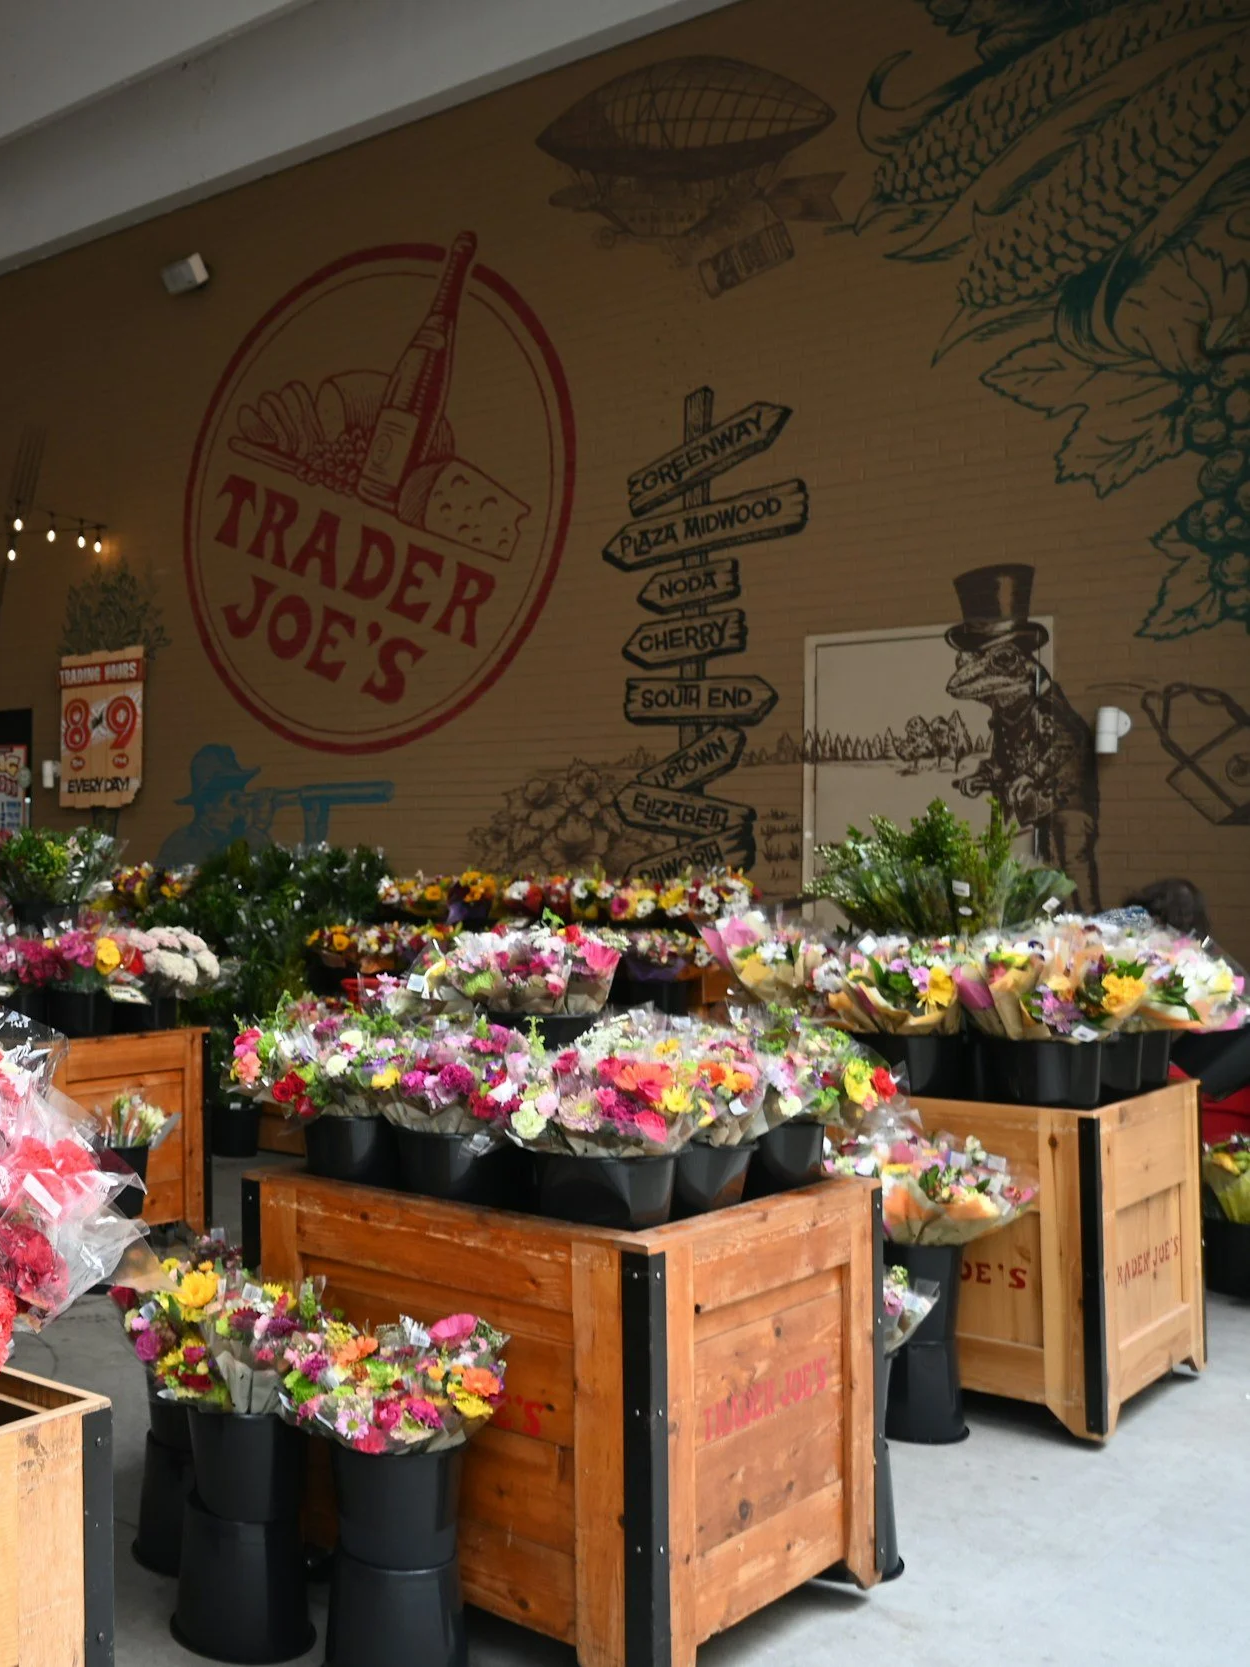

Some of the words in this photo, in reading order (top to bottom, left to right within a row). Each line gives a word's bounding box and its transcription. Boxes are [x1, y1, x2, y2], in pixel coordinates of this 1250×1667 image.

[640, 409, 764, 490] GREENWAY
[620, 522, 679, 556] PLAZA
[683, 497, 782, 539] MIDWOOD
[214, 474, 496, 648] TRADER
[659, 571, 717, 599] NODA
[220, 574, 428, 704] JOE'S
[638, 617, 729, 652] CHERRY
[59, 665, 101, 687] TRADING
[640, 685, 700, 709] SOUTH
[707, 686, 752, 709] END
[65, 699, 91, 752] 8
[107, 695, 137, 749] 9
[653, 735, 729, 788] UPTOWN
[68, 778, 104, 794] EVERY
[633, 792, 729, 830] ELIZABETH
[961, 1259, 1028, 1290] OE'S
[781, 1355, 829, 1407] JOE'S
